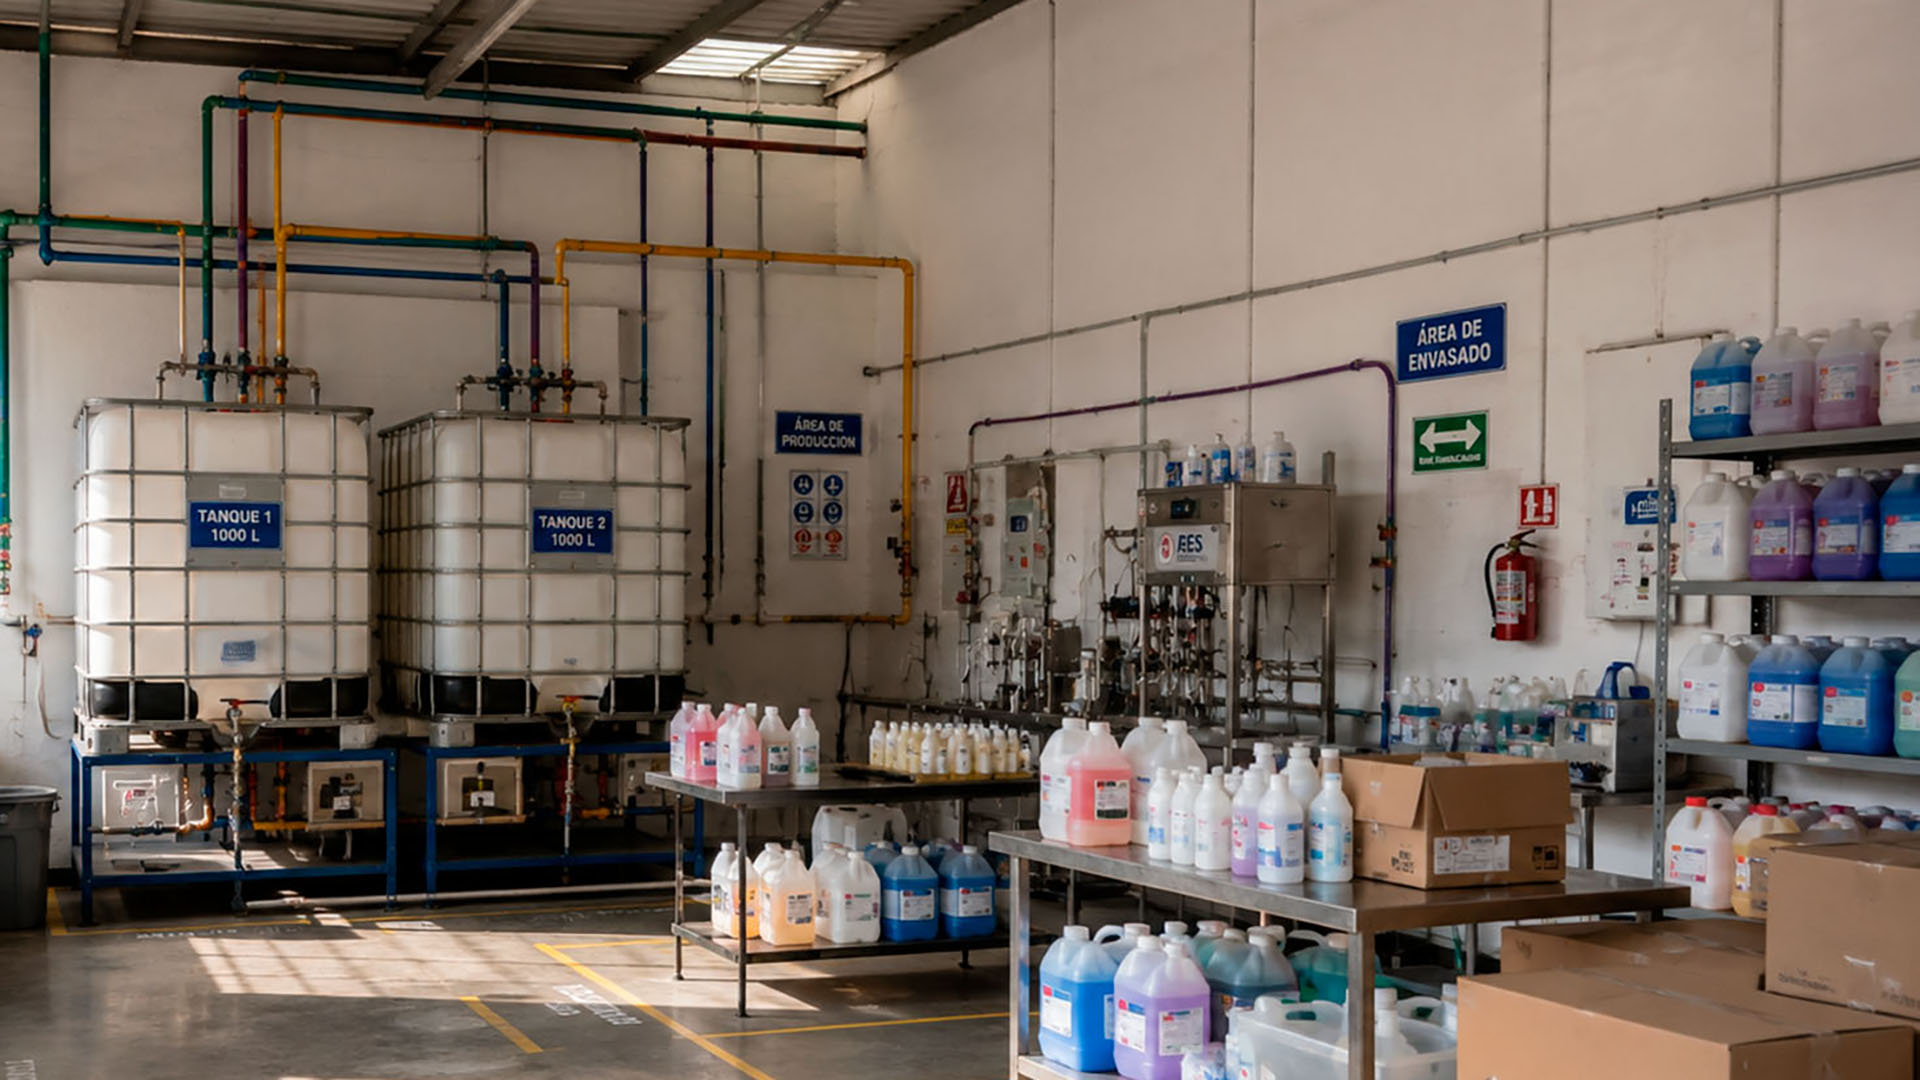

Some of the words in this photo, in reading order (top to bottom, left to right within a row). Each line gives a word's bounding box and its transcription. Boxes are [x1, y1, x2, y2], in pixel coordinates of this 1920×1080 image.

[1417, 322, 1457, 347] ÁREA
[1462, 318, 1482, 339] DE
[1408, 342, 1491, 372] ENVASADO
[795, 415, 826, 432] ÁREA
[829, 420, 844, 433] DE
[197, 509, 260, 524] TANQUE
[264, 510, 271, 524] 1
[598, 516, 606, 530] 2
[211, 528, 247, 542] 1000
[251, 529, 260, 543] L
[552, 533, 583, 547] 1000
[587, 533, 596, 547] L
